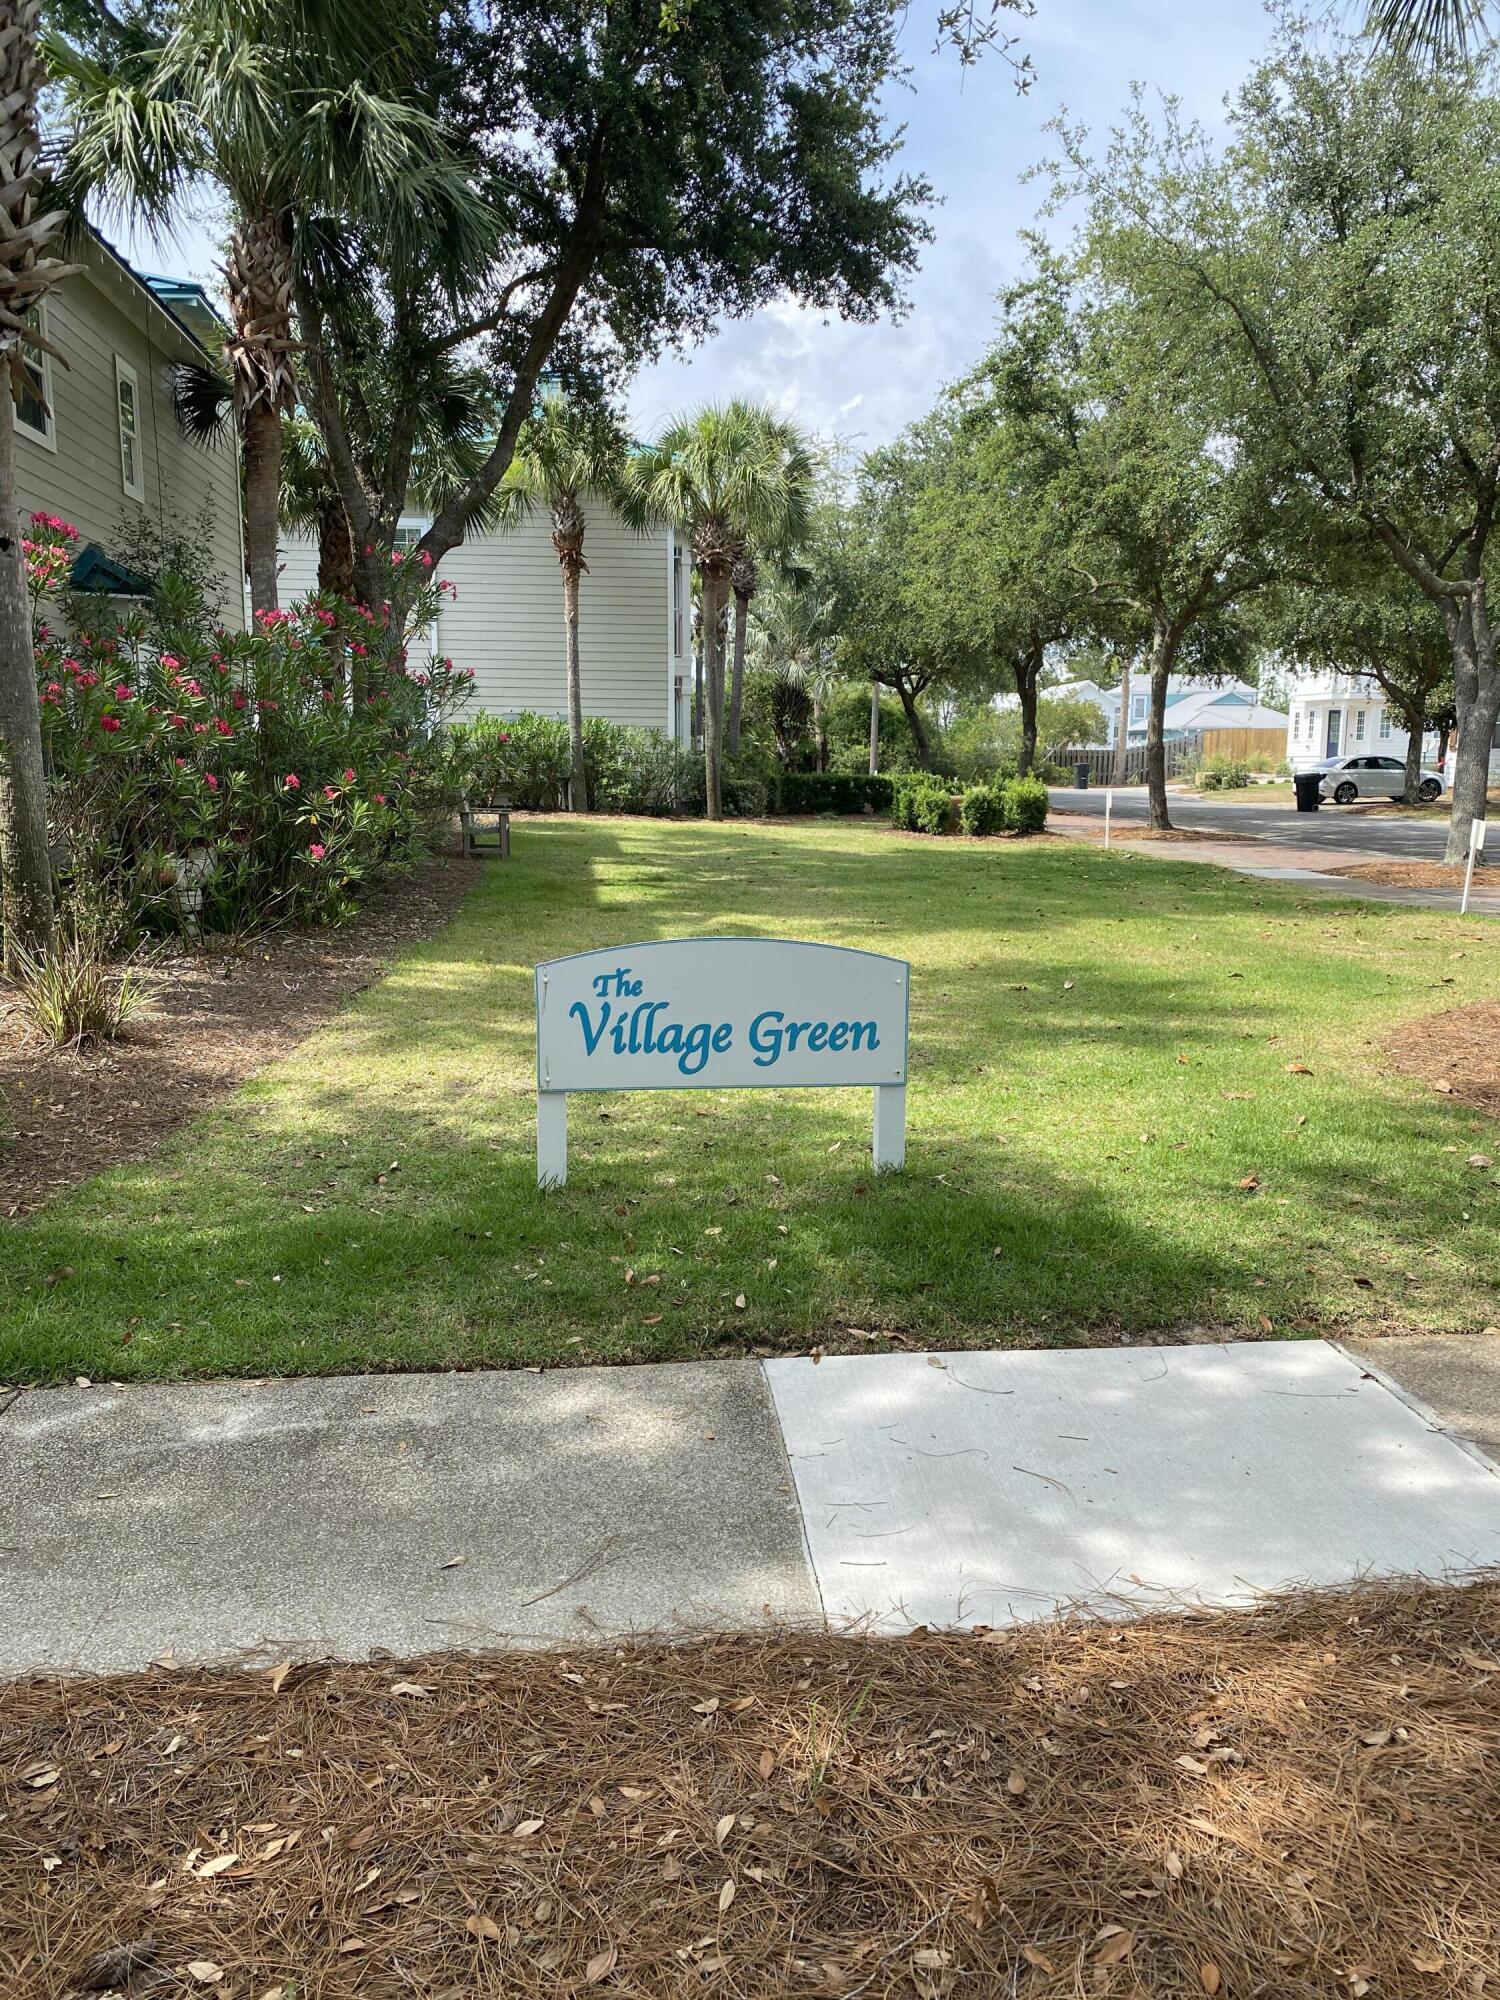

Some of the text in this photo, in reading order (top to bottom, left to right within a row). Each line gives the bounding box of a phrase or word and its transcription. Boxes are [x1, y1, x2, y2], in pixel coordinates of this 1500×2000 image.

[592, 967, 644, 998] The
[568, 1000, 881, 1076] Village Green
